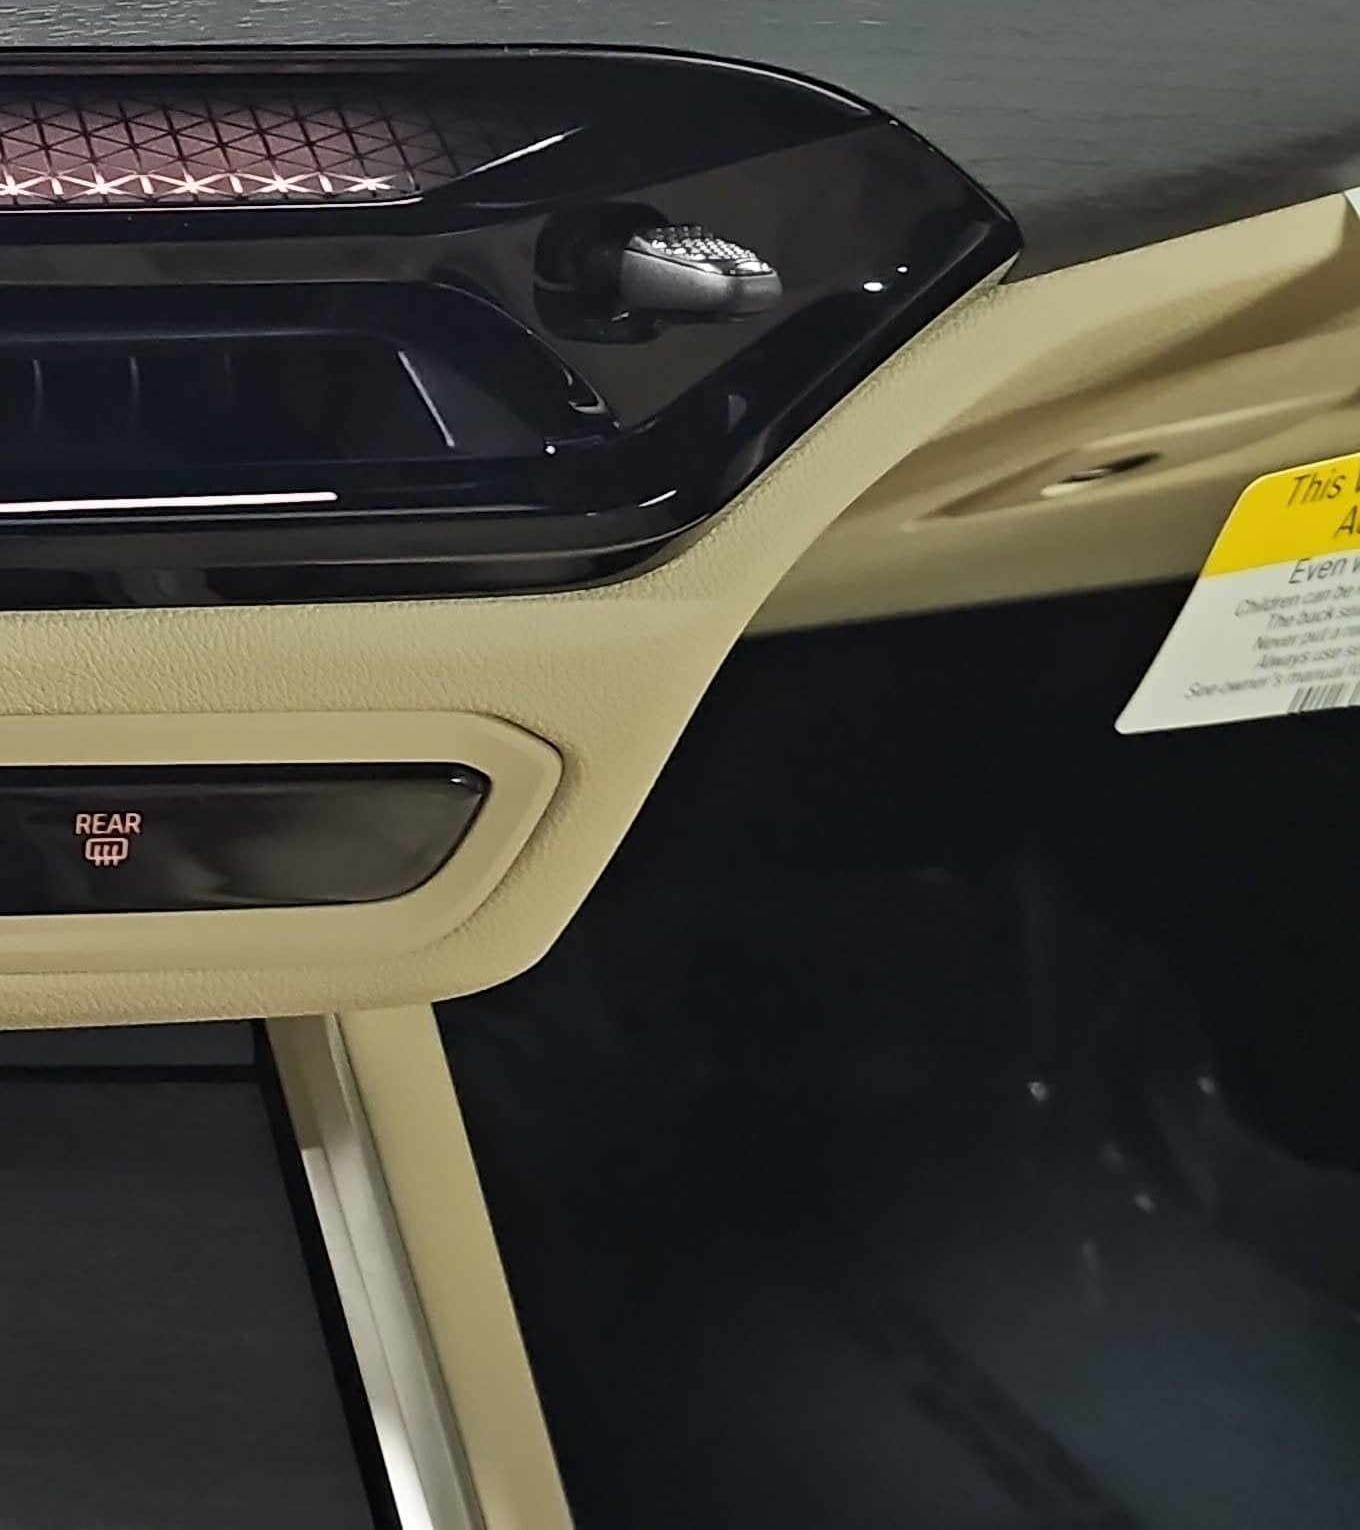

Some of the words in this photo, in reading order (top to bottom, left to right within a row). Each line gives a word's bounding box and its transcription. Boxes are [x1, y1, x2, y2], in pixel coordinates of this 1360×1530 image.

[1287, 468, 1347, 508] This
[1288, 556, 1348, 585] Even
[75, 812, 142, 835] REAR
